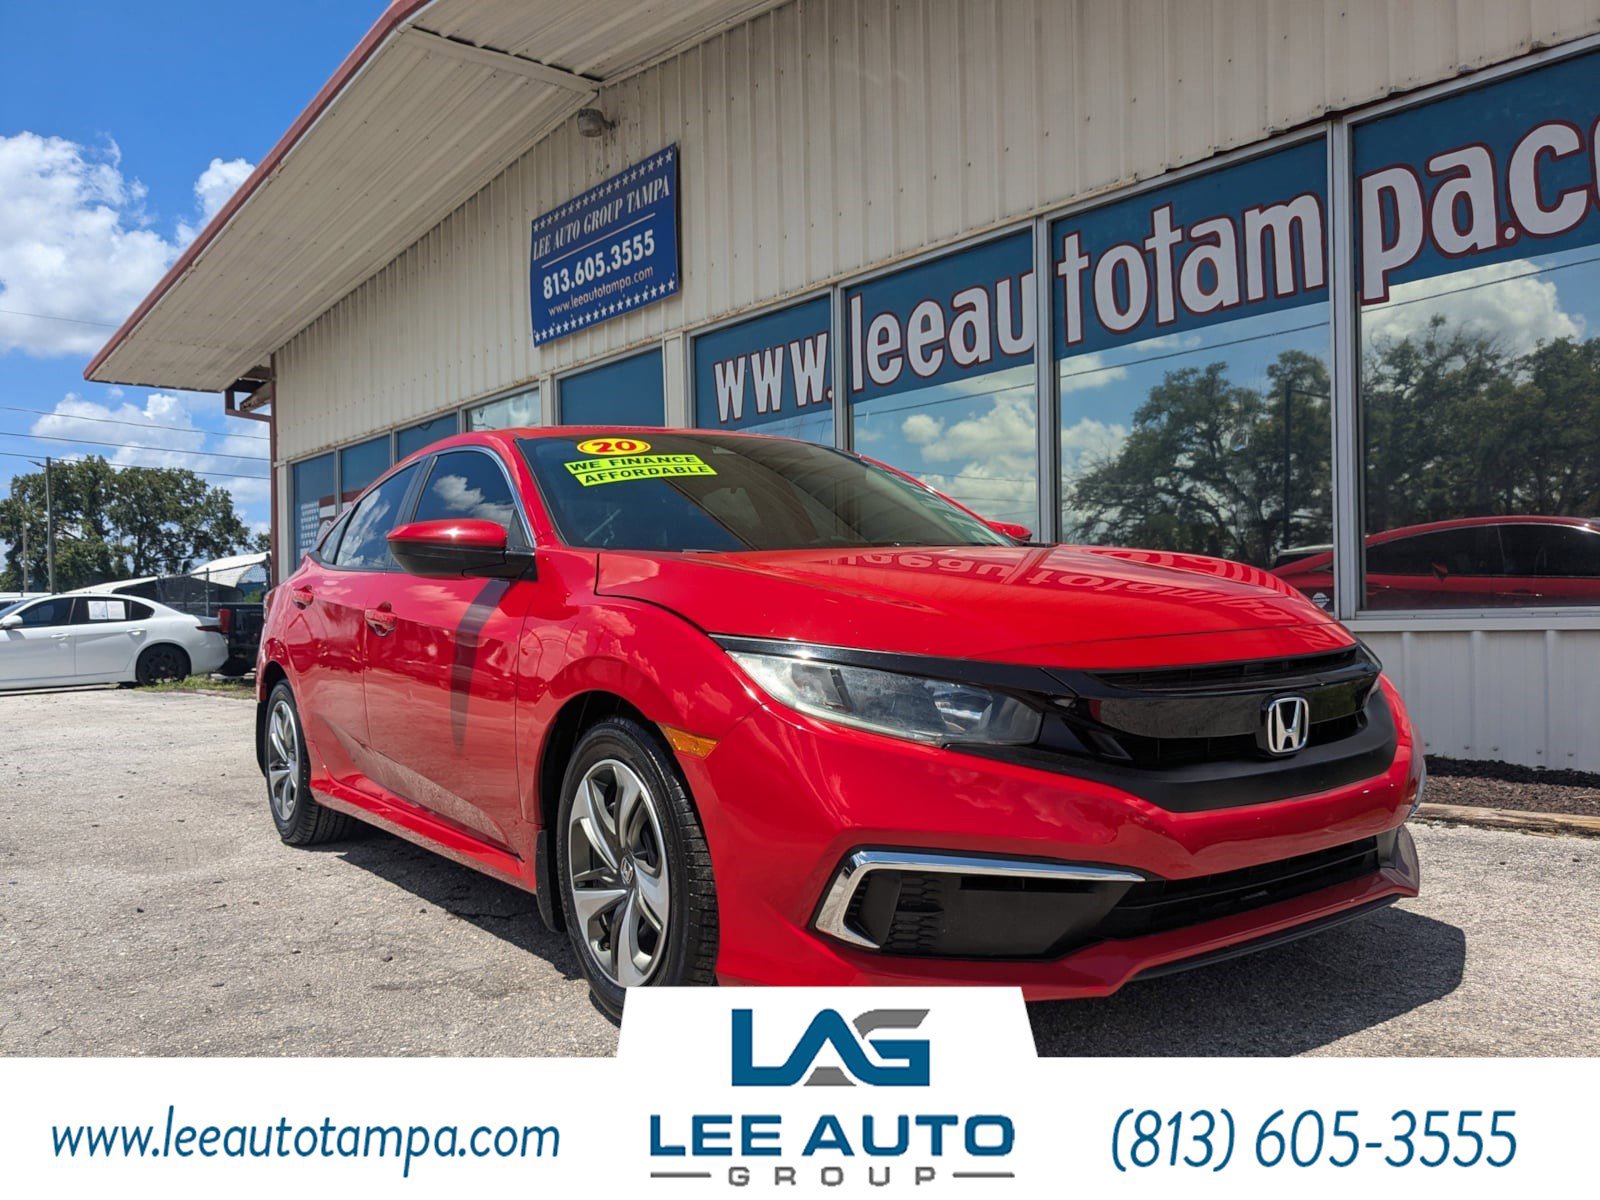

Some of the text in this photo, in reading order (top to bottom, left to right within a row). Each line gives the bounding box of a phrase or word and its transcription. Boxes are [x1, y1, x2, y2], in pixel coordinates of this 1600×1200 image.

[533, 175, 670, 261] LEE AUTO GROUP TAMPA
[543, 229, 655, 299] 813.605.3555
[714, 114, 1600, 424] www.leeautotampa.c
[548, 265, 654, 316] www.leeautotampa.com
[569, 456, 697, 471] WE FINANCE
[592, 440, 637, 453] 20
[585, 465, 711, 484] AFFORDABLE
